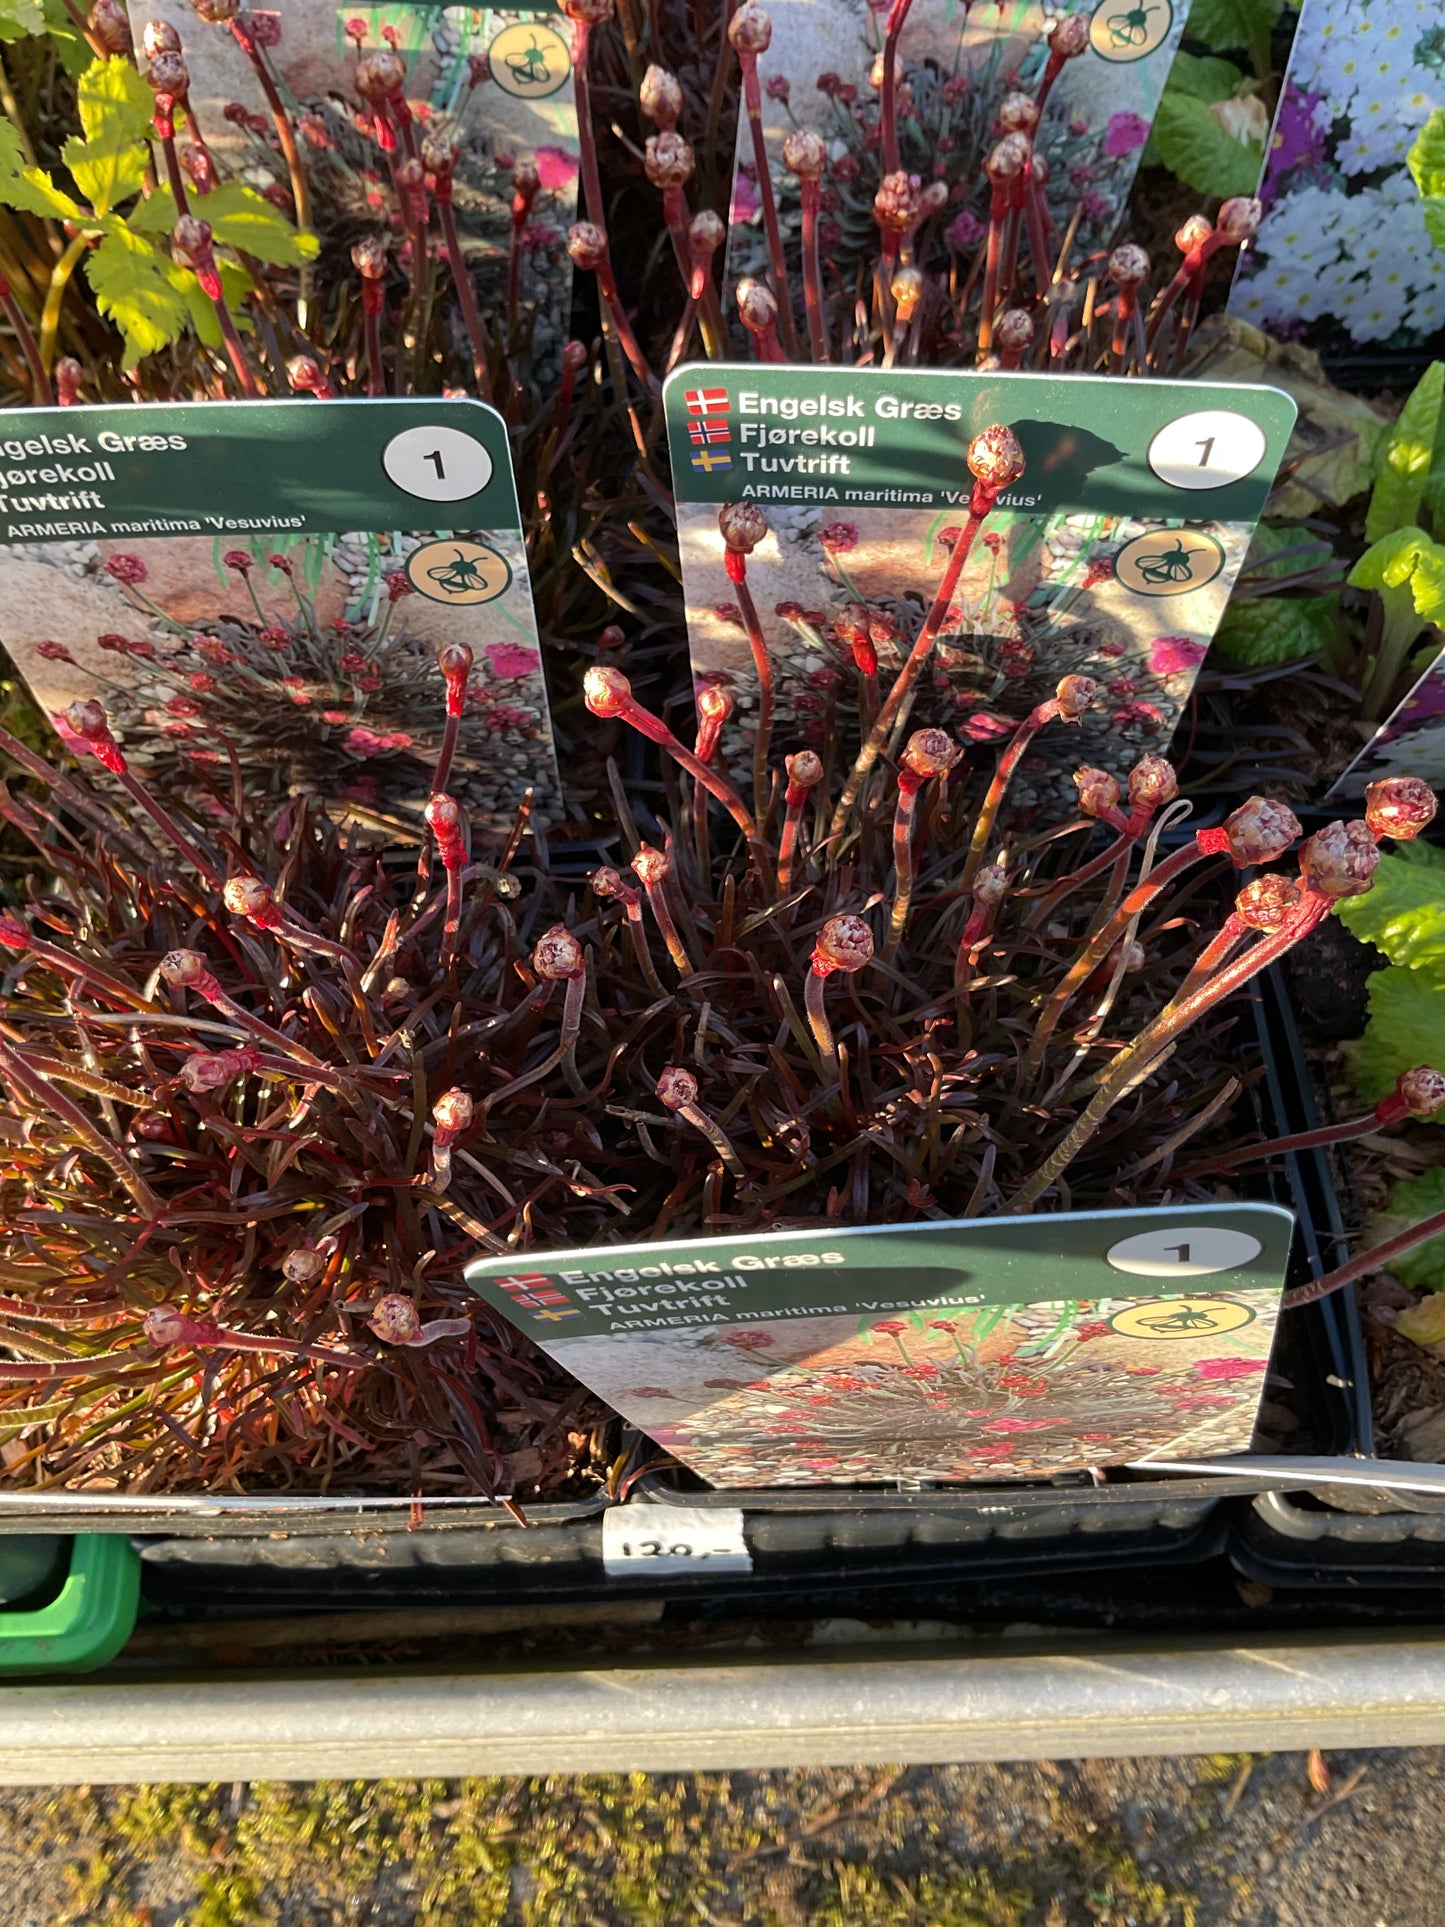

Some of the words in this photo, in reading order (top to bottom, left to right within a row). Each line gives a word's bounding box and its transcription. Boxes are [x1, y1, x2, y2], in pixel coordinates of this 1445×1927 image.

[738, 392, 865, 420] Engelsk
[874, 396, 962, 421] Græs
[0, 434, 93, 461] gelsk
[97, 431, 188, 453] Græs
[739, 423, 875, 448] Fjørekoll
[422, 450, 446, 480] 1
[740, 452, 850, 475] Tuvtrift
[1194, 436, 1216, 467] 1
[742, 484, 839, 500] ARMERIA
[845, 489, 933, 503] maritima
[940, 490, 1042, 507] 'Vevius'
[8, 521, 107, 538] ARMERIA
[111, 518, 201, 533] maritima
[205, 514, 306, 530] 'Vesuvius'
[1163, 1243, 1190, 1262] 1
[559, 1259, 721, 1284] Engelsk
[731, 1251, 845, 1271] Græs
[575, 1275, 748, 1302] Fjørekoll
[589, 1293, 731, 1316] Tuvtrift
[609, 1312, 729, 1331] ARMERIA
[736, 1303, 848, 1320] maritima
